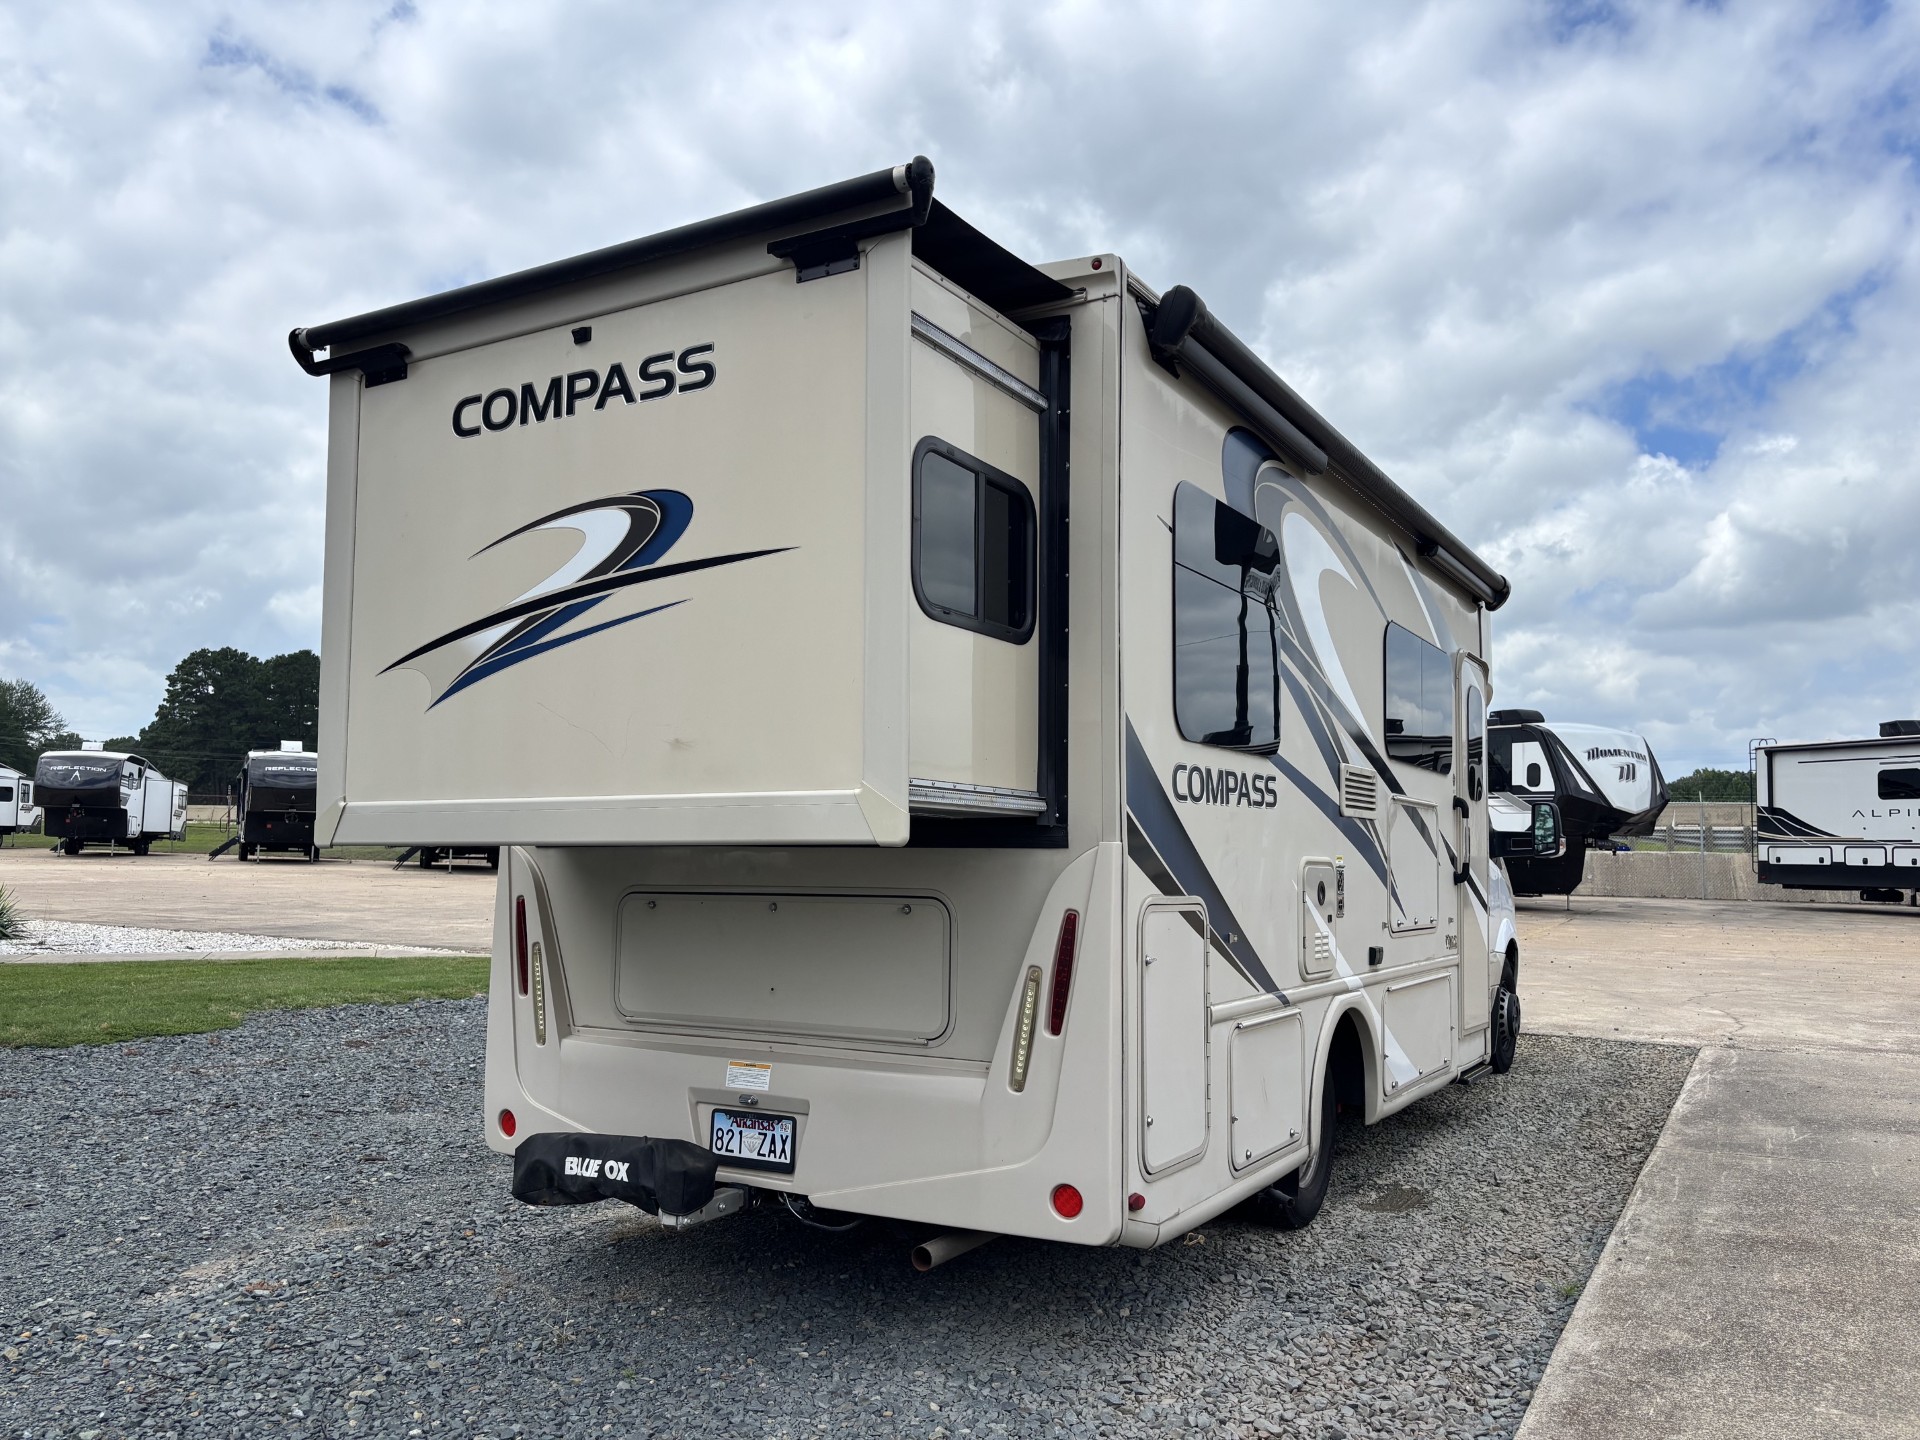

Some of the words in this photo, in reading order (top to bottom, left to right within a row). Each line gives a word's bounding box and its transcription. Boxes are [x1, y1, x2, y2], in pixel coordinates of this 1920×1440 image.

[452, 341, 717, 439] COMPASS
[50, 765, 107, 773] REFLECTION
[1171, 762, 1278, 809] COMPASS
[1852, 808, 1920, 818] ALPI
[730, 1117, 776, 1132] Arkansas
[715, 1127, 742, 1154] 821
[757, 1132, 789, 1160] ZAX
[564, 1156, 603, 1178] BLUE
[604, 1160, 630, 1182] OX
